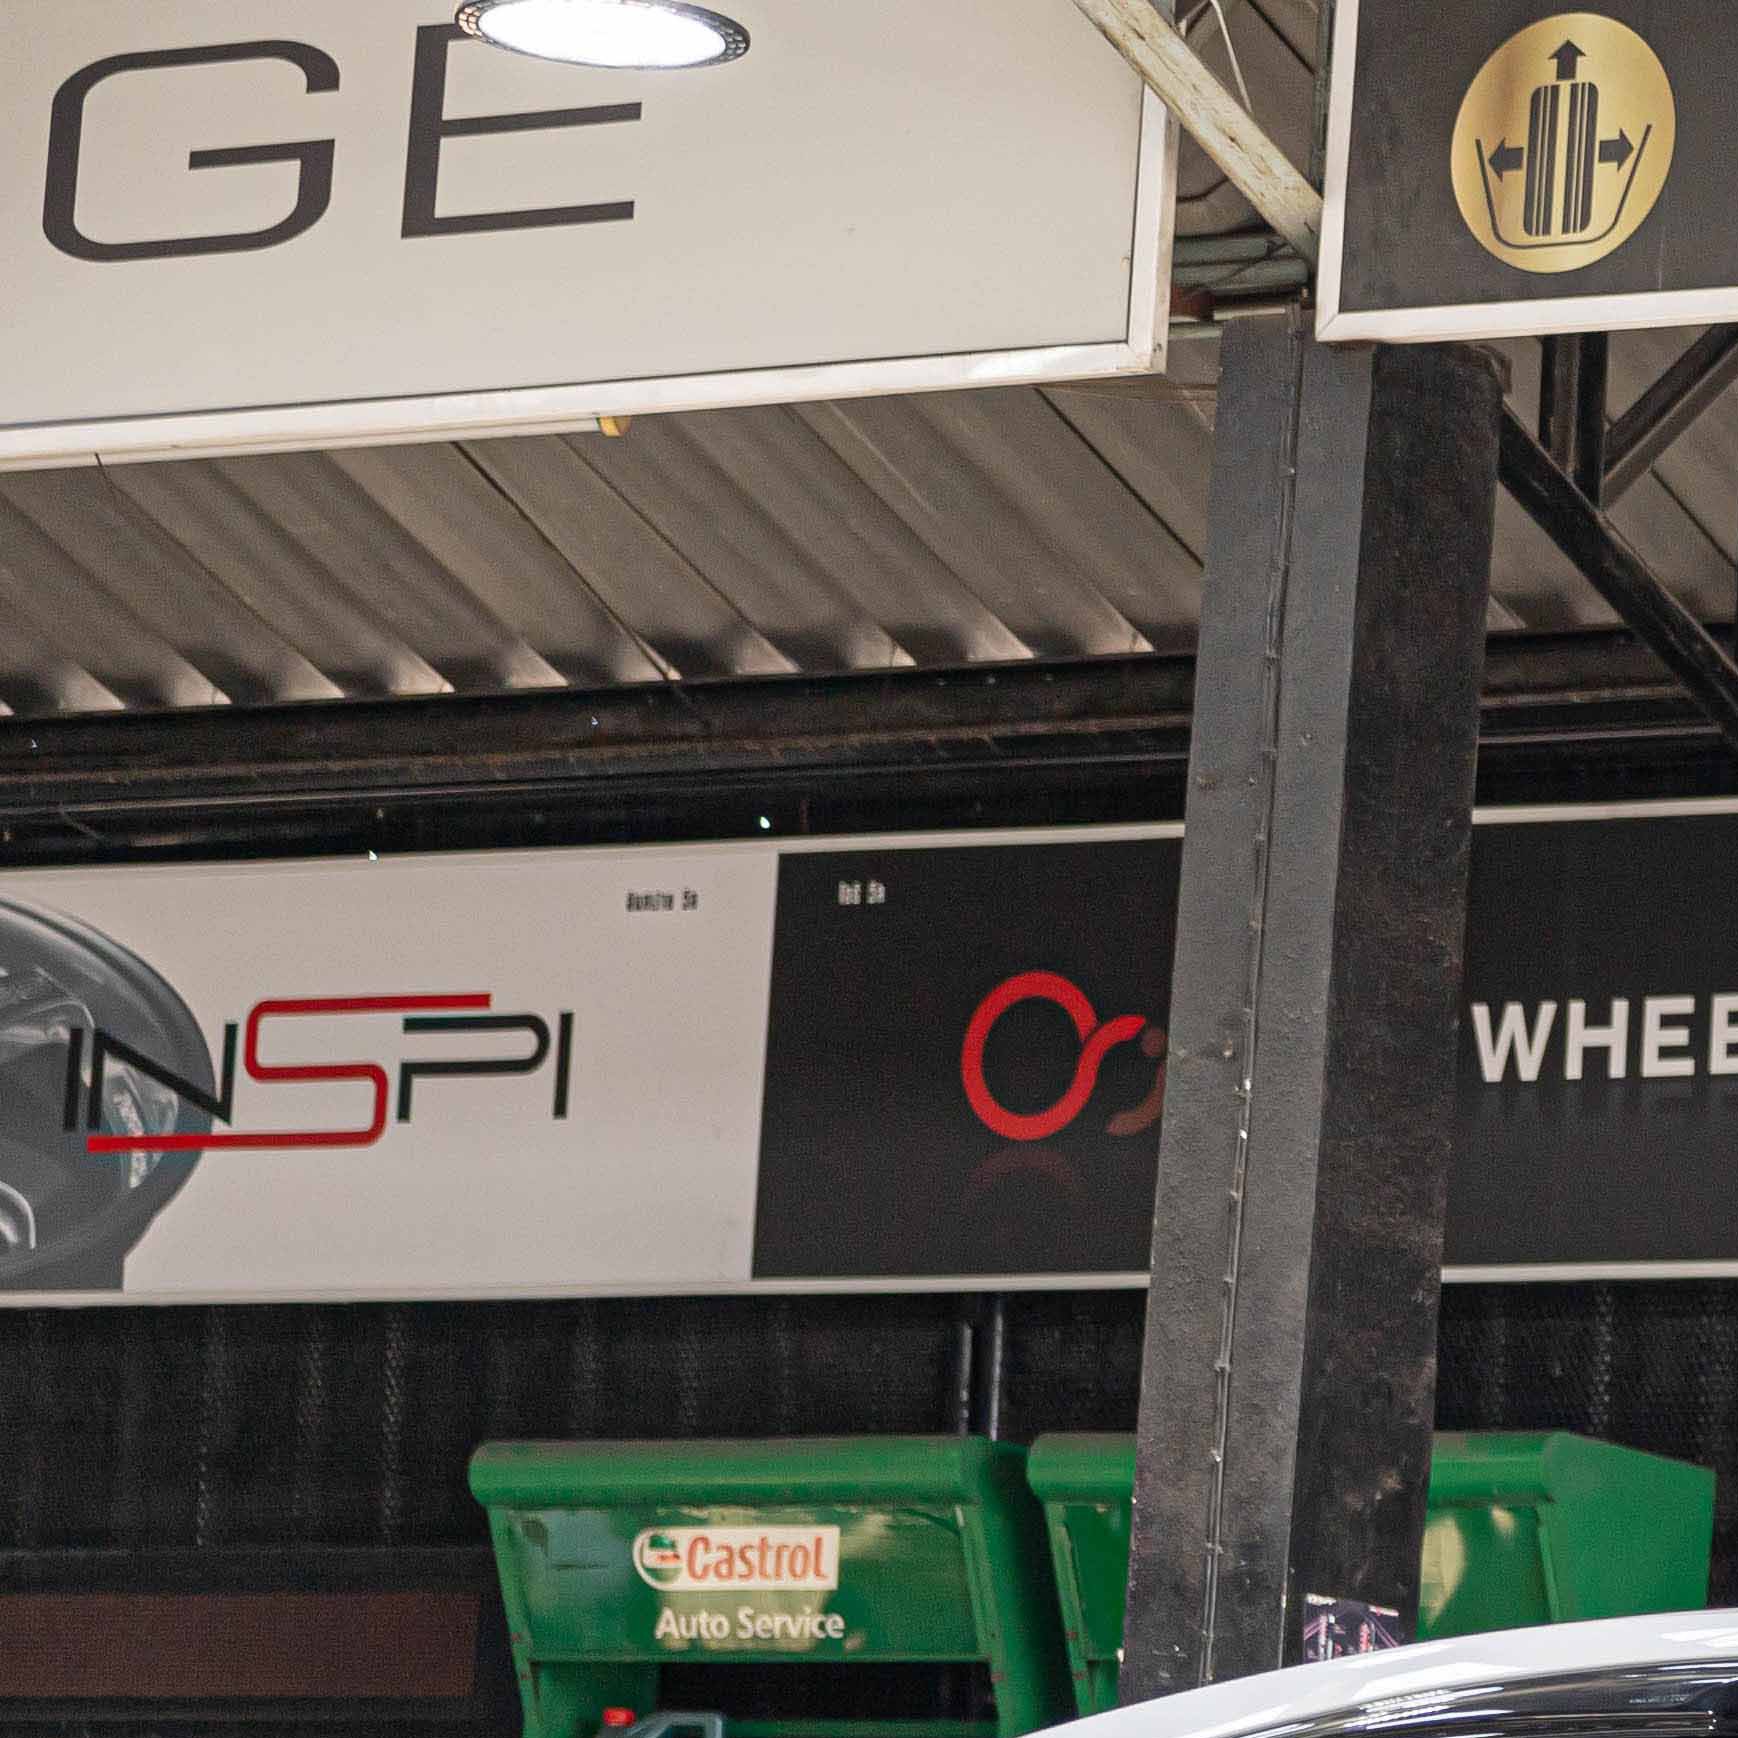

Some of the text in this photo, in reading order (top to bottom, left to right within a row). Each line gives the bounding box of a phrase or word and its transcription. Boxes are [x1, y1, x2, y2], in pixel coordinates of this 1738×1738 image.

[42, 24, 642, 263] GE
[686, 1534, 830, 1582] Castrol
[654, 1605, 846, 1640] Auto Service
